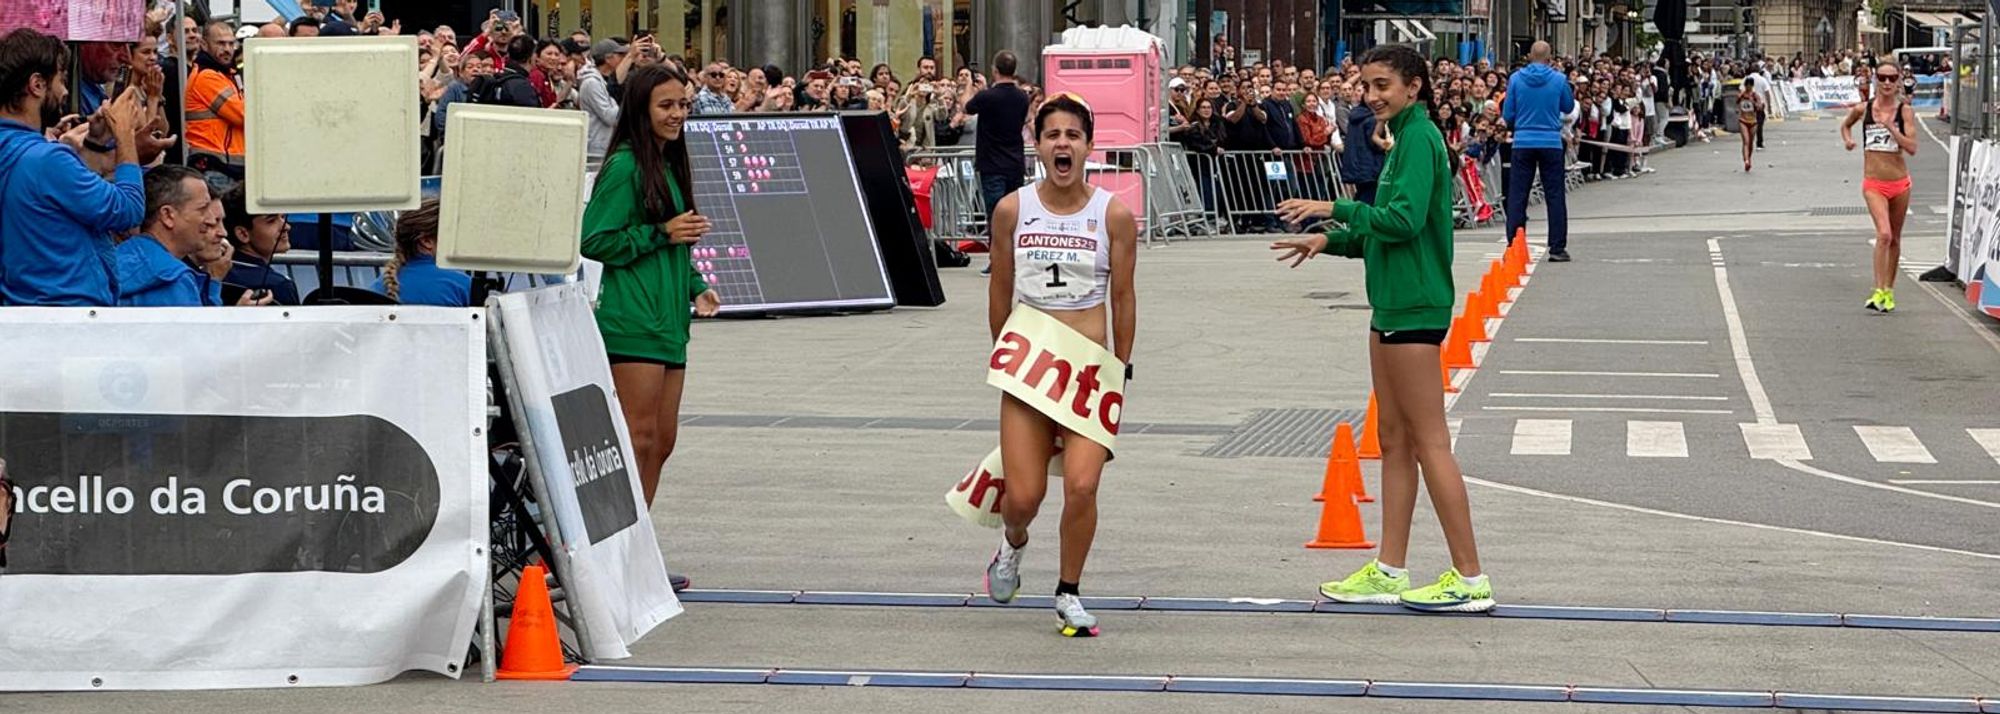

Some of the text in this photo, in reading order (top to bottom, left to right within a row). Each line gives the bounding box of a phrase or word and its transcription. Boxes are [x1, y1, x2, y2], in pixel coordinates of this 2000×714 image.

[1020, 235, 1095, 250] CANTONES25
[1067, 252, 1080, 262] M.
[1045, 263, 1067, 287] 1
[990, 331, 1123, 436] anto
[150, 477, 206, 514] da
[222, 474, 385, 514] Coruña
